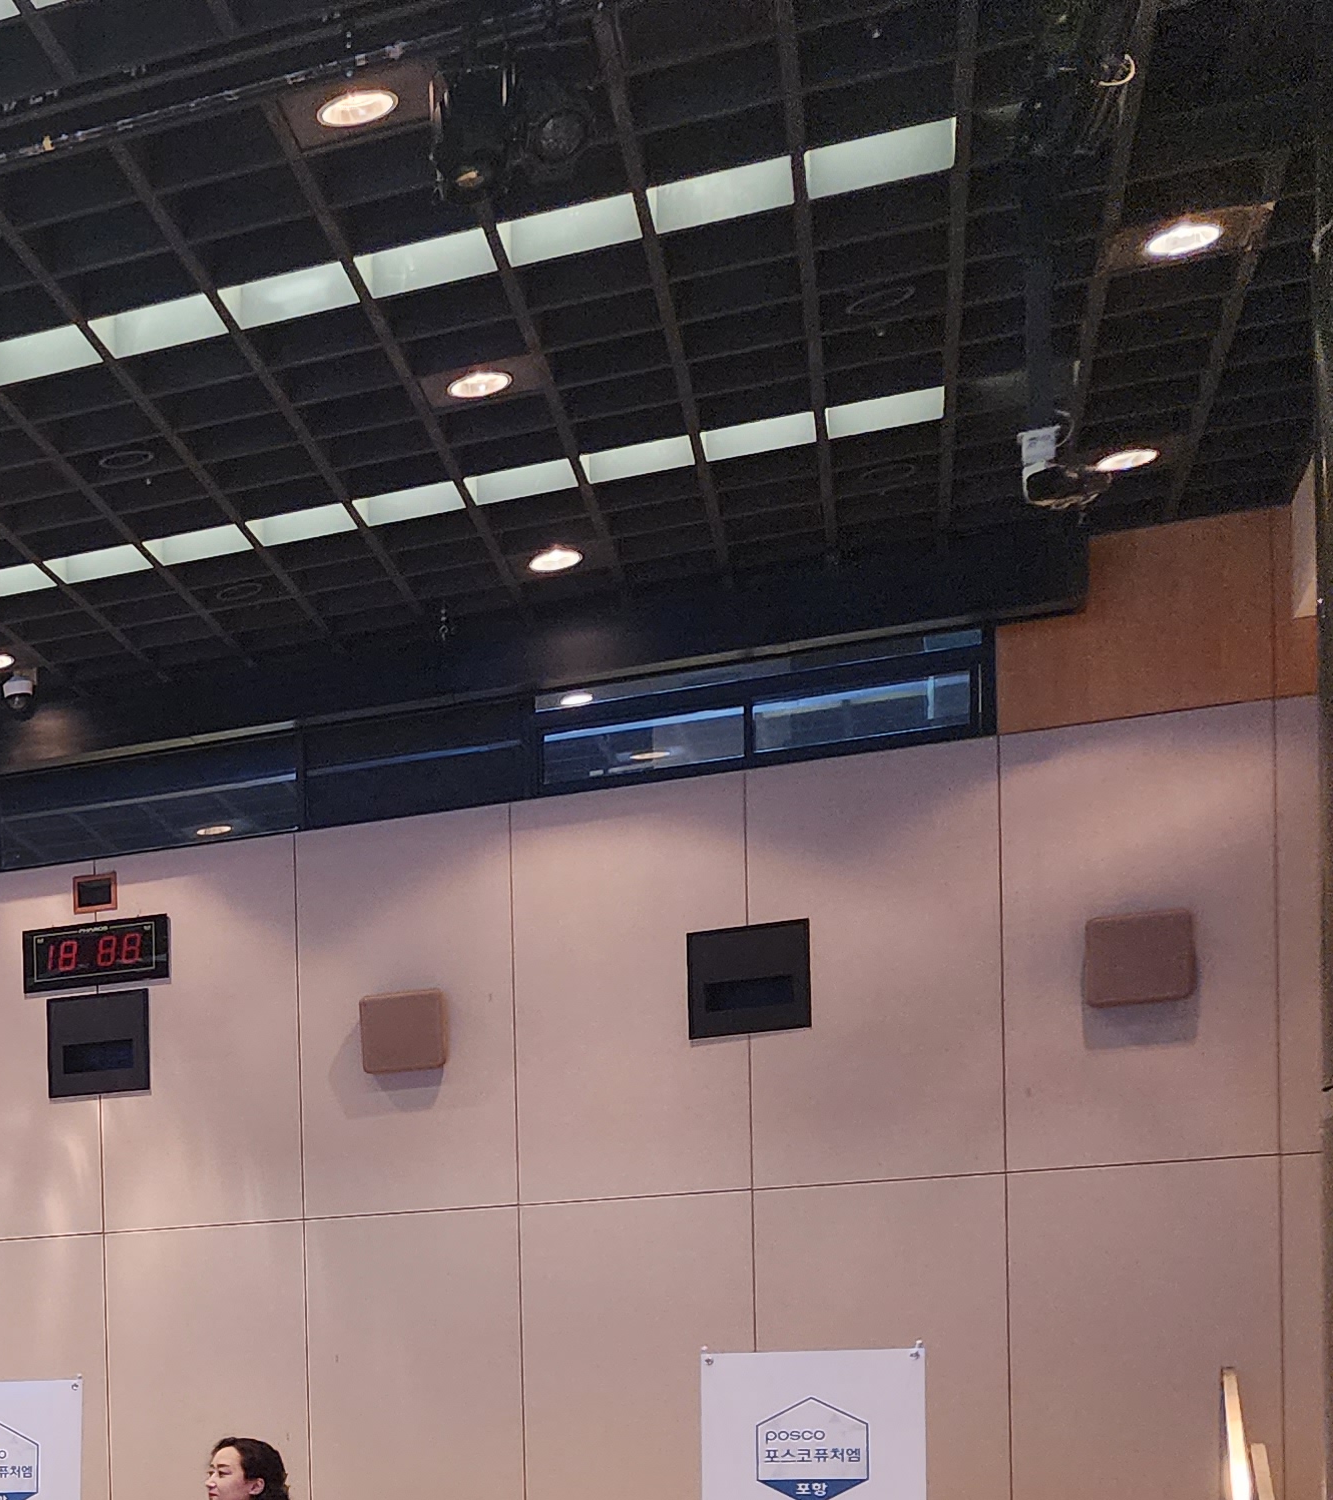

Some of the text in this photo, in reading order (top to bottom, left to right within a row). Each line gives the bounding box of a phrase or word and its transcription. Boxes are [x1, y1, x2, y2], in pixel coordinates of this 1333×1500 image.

[766, 1430, 825, 1444] posco
[764, 1448, 861, 1463] 포스코퓨처엠
[795, 1482, 828, 1497] 포항
